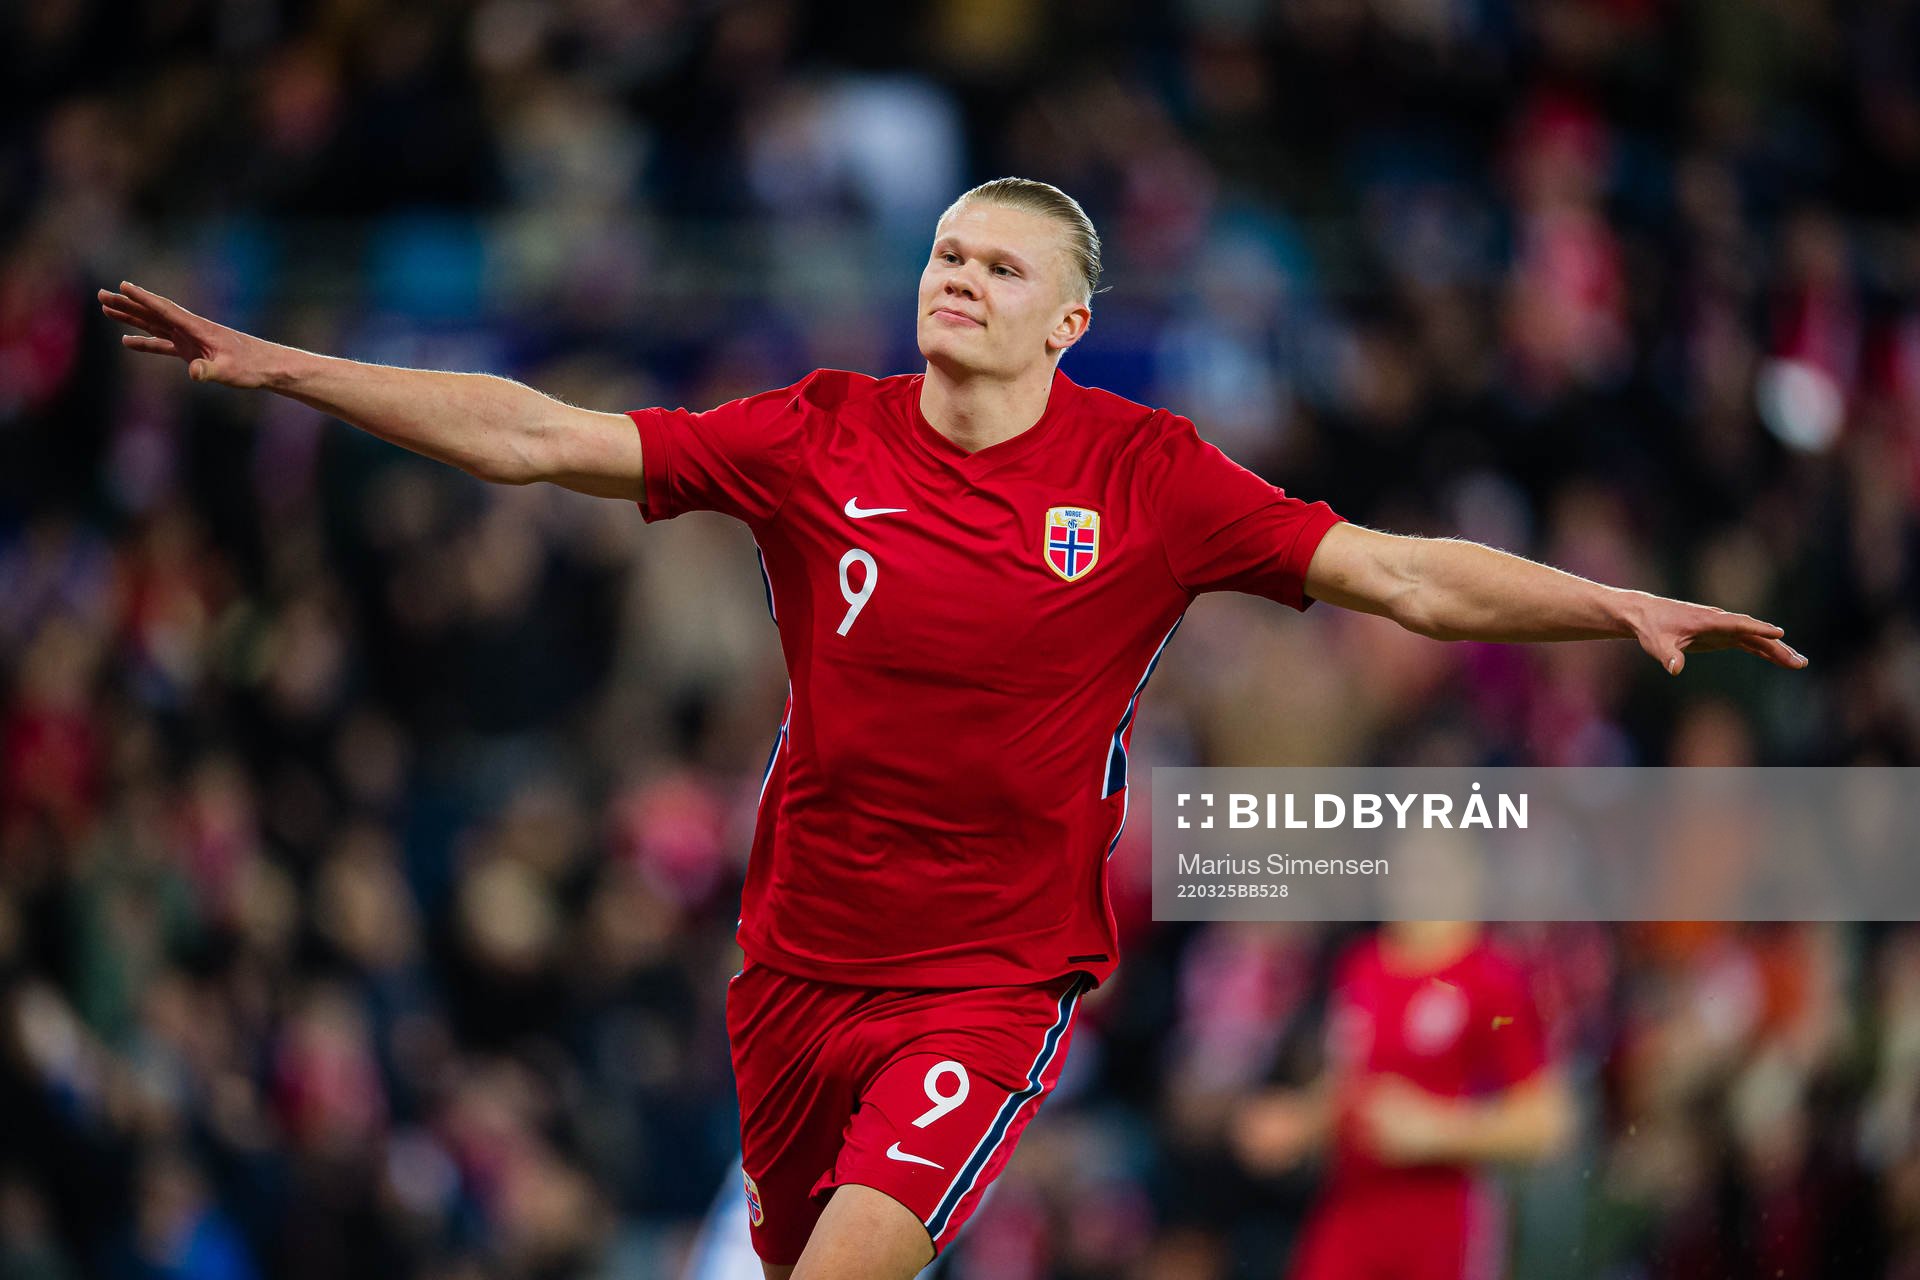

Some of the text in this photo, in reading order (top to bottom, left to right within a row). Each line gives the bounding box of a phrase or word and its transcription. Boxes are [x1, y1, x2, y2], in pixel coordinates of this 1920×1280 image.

[1065, 510, 1082, 518] NORGE
[836, 548, 878, 637] 9
[911, 1060, 970, 1129] 9
